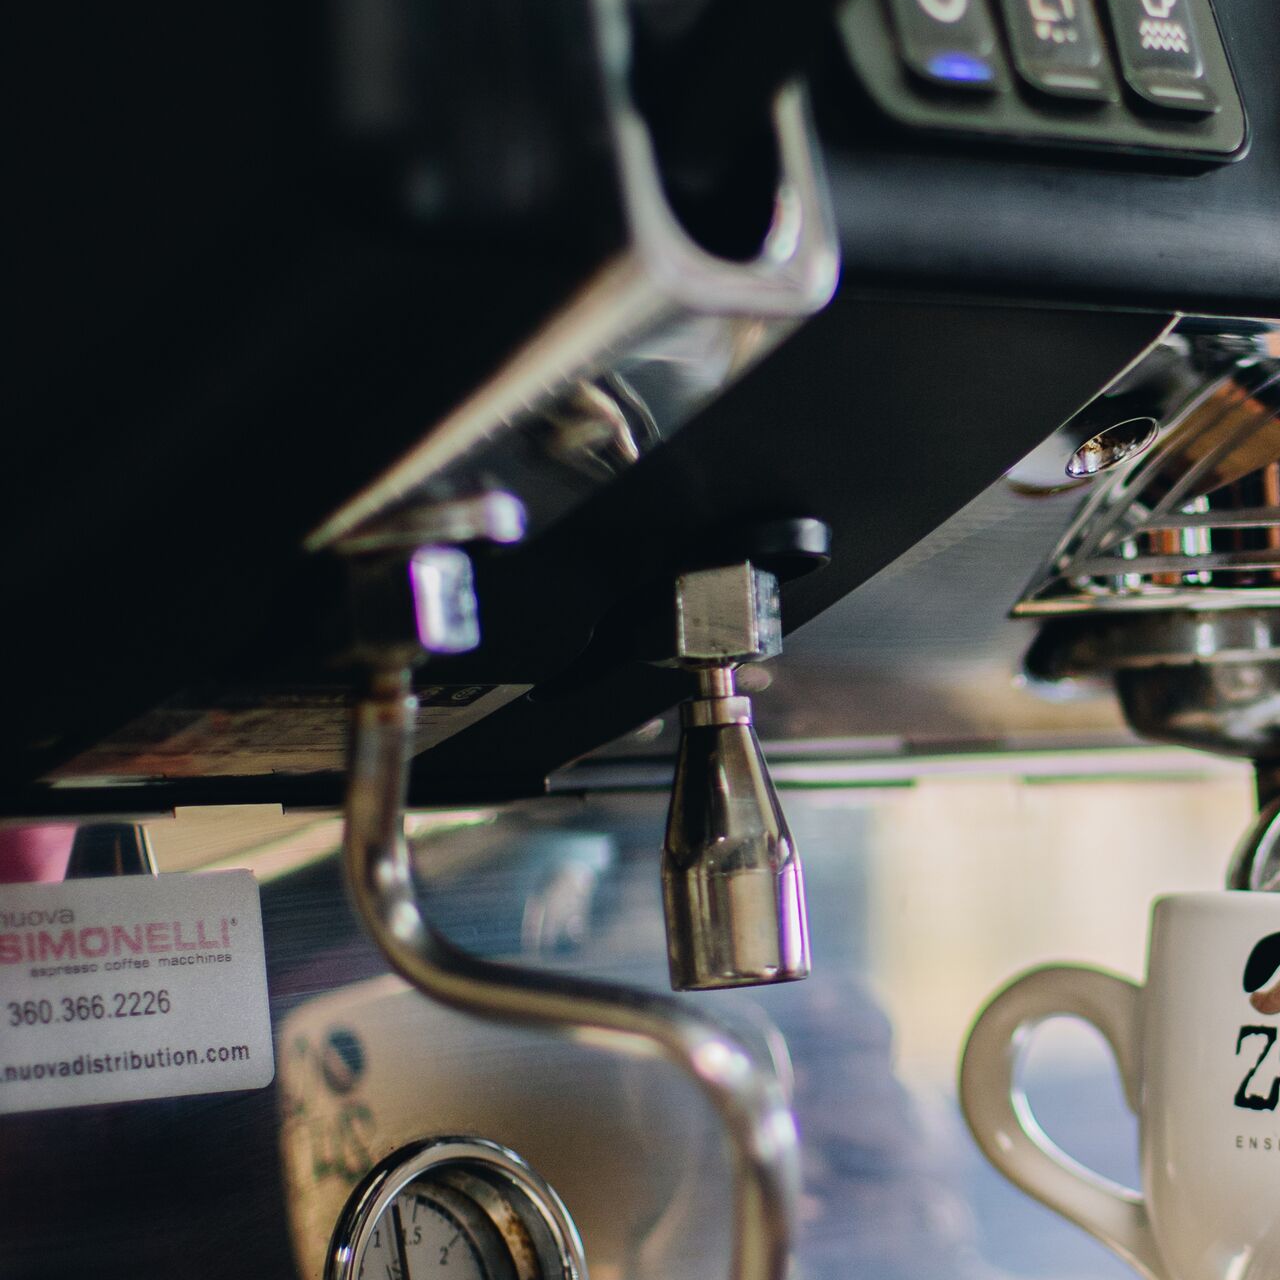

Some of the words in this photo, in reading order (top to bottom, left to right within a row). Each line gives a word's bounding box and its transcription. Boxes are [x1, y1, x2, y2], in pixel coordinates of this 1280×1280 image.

[30, 963, 98, 978] espresso
[104, 958, 150, 971] coffee
[159, 953, 233, 967] macchines
[7, 989, 171, 1027] 360.366.2226
[373, 1230, 381, 1248] 1
[439, 1246, 448, 1265] 2
